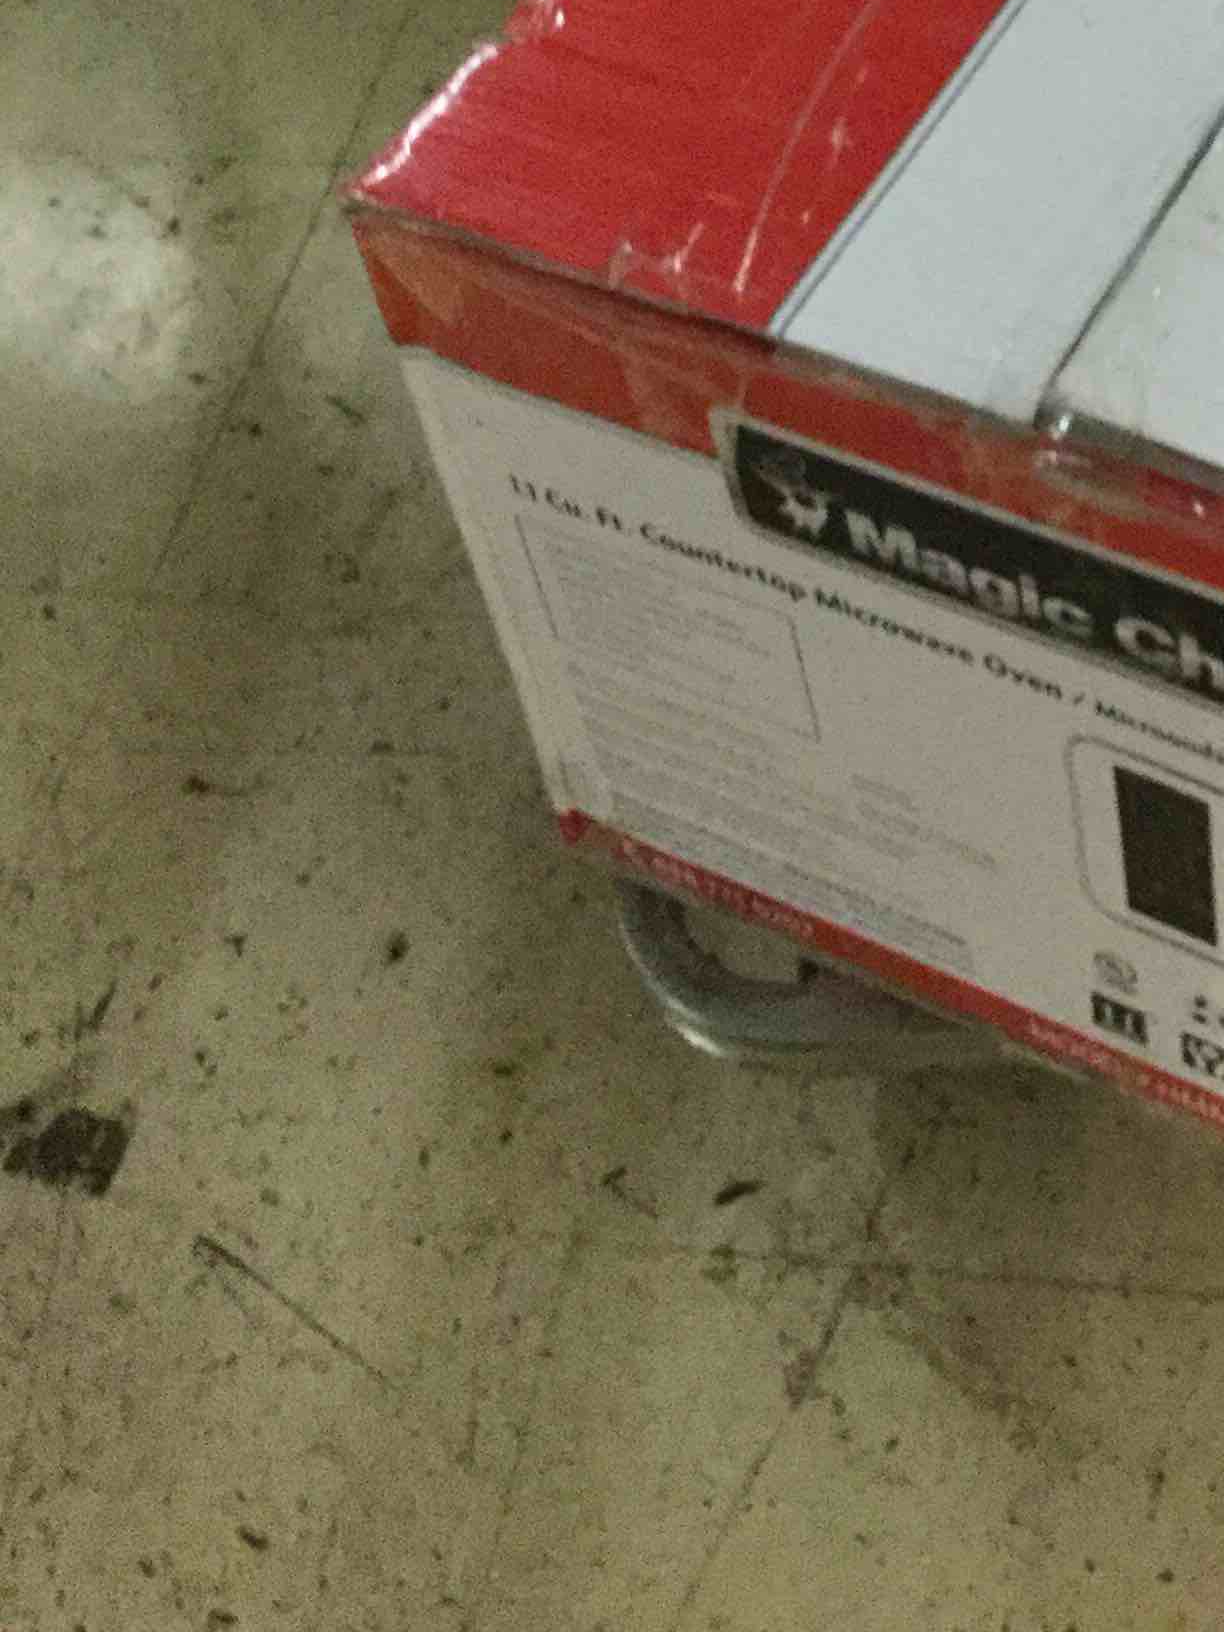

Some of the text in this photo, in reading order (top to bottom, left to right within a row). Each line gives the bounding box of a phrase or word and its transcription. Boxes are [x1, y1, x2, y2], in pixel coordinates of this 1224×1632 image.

[639, 523, 807, 602] Countertop
[814, 585, 975, 666] Microwave
[983, 652, 1063, 701] Oven
[844, 508, 1095, 638] Magic
